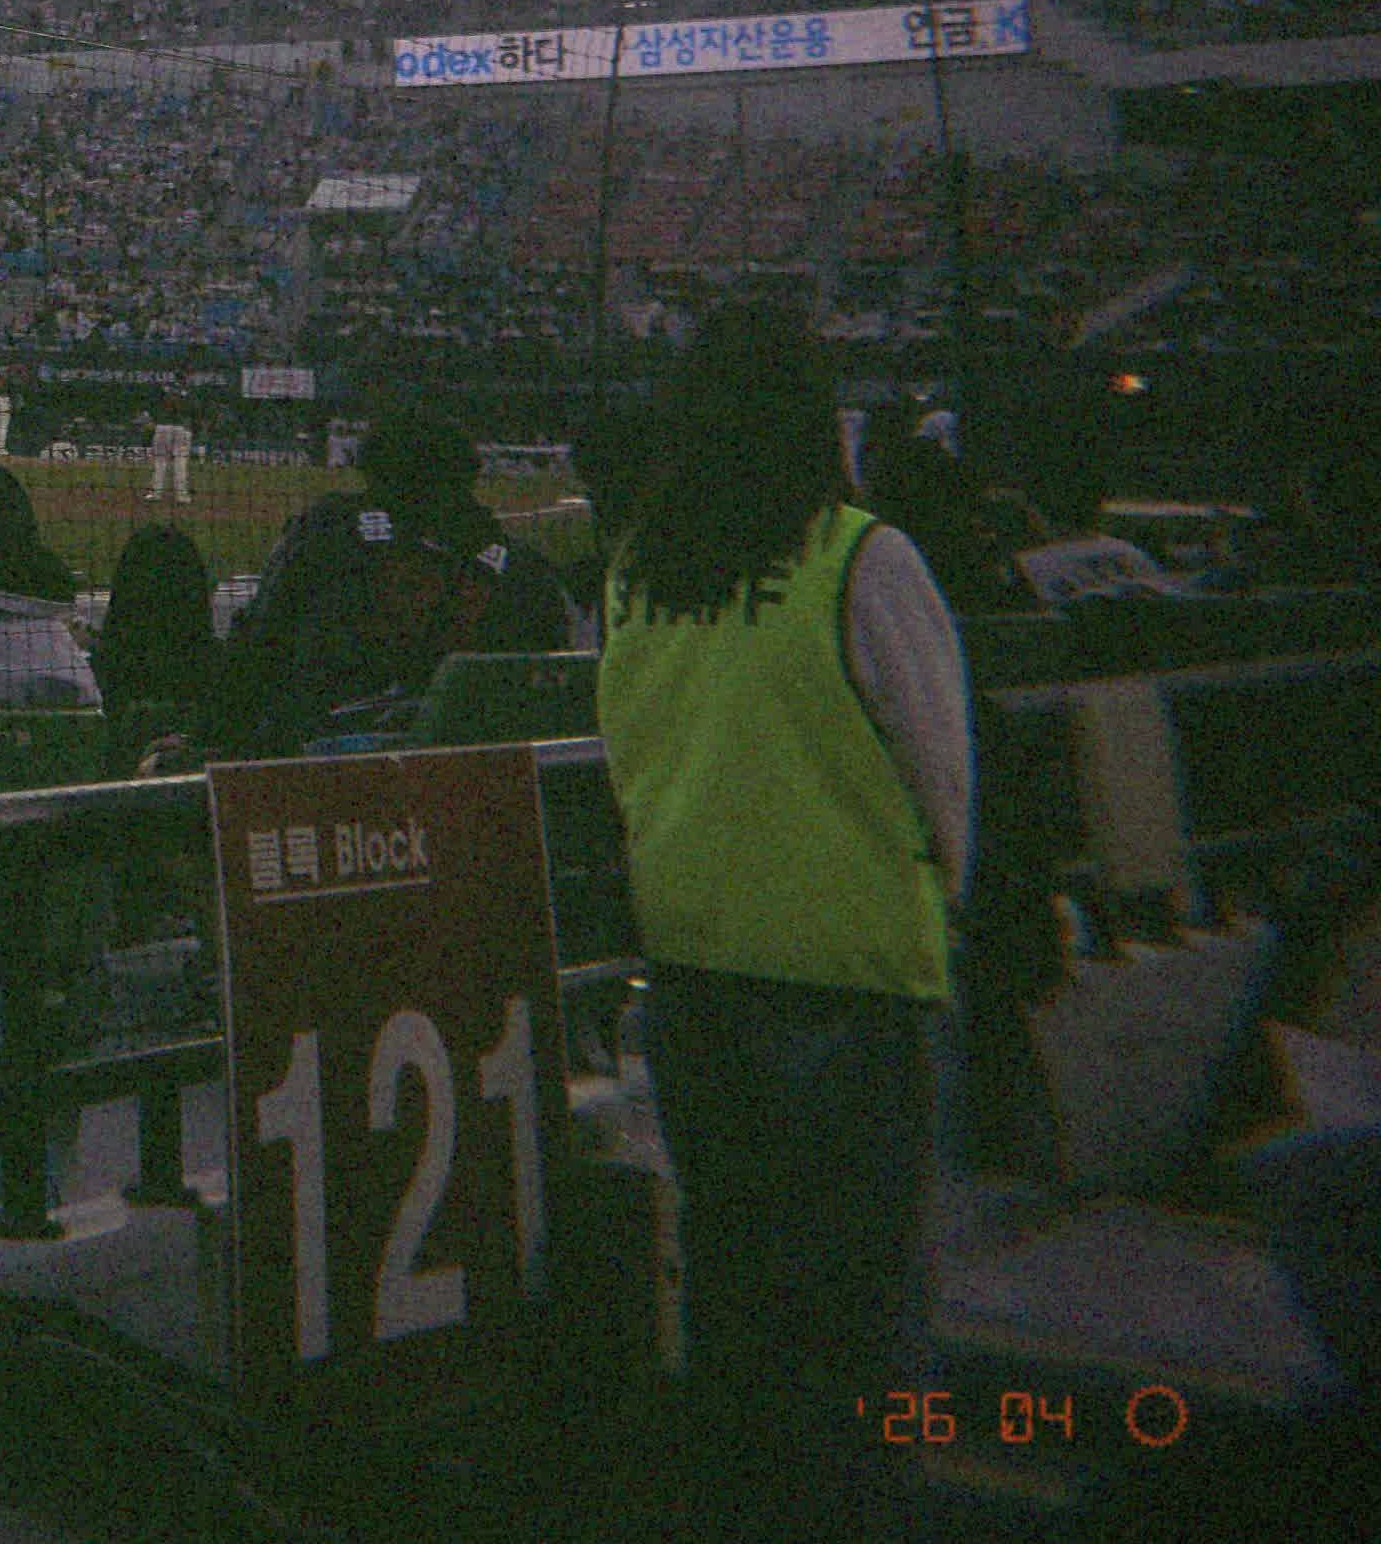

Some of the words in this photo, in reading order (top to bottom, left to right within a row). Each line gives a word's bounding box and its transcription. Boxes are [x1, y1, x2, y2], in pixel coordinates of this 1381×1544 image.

[636, 15, 831, 68] 삼성자산운용
[902, 4, 981, 50] 연금
[247, 824, 320, 890] 블록
[334, 821, 429, 875] Block
[255, 991, 547, 1360] 121
